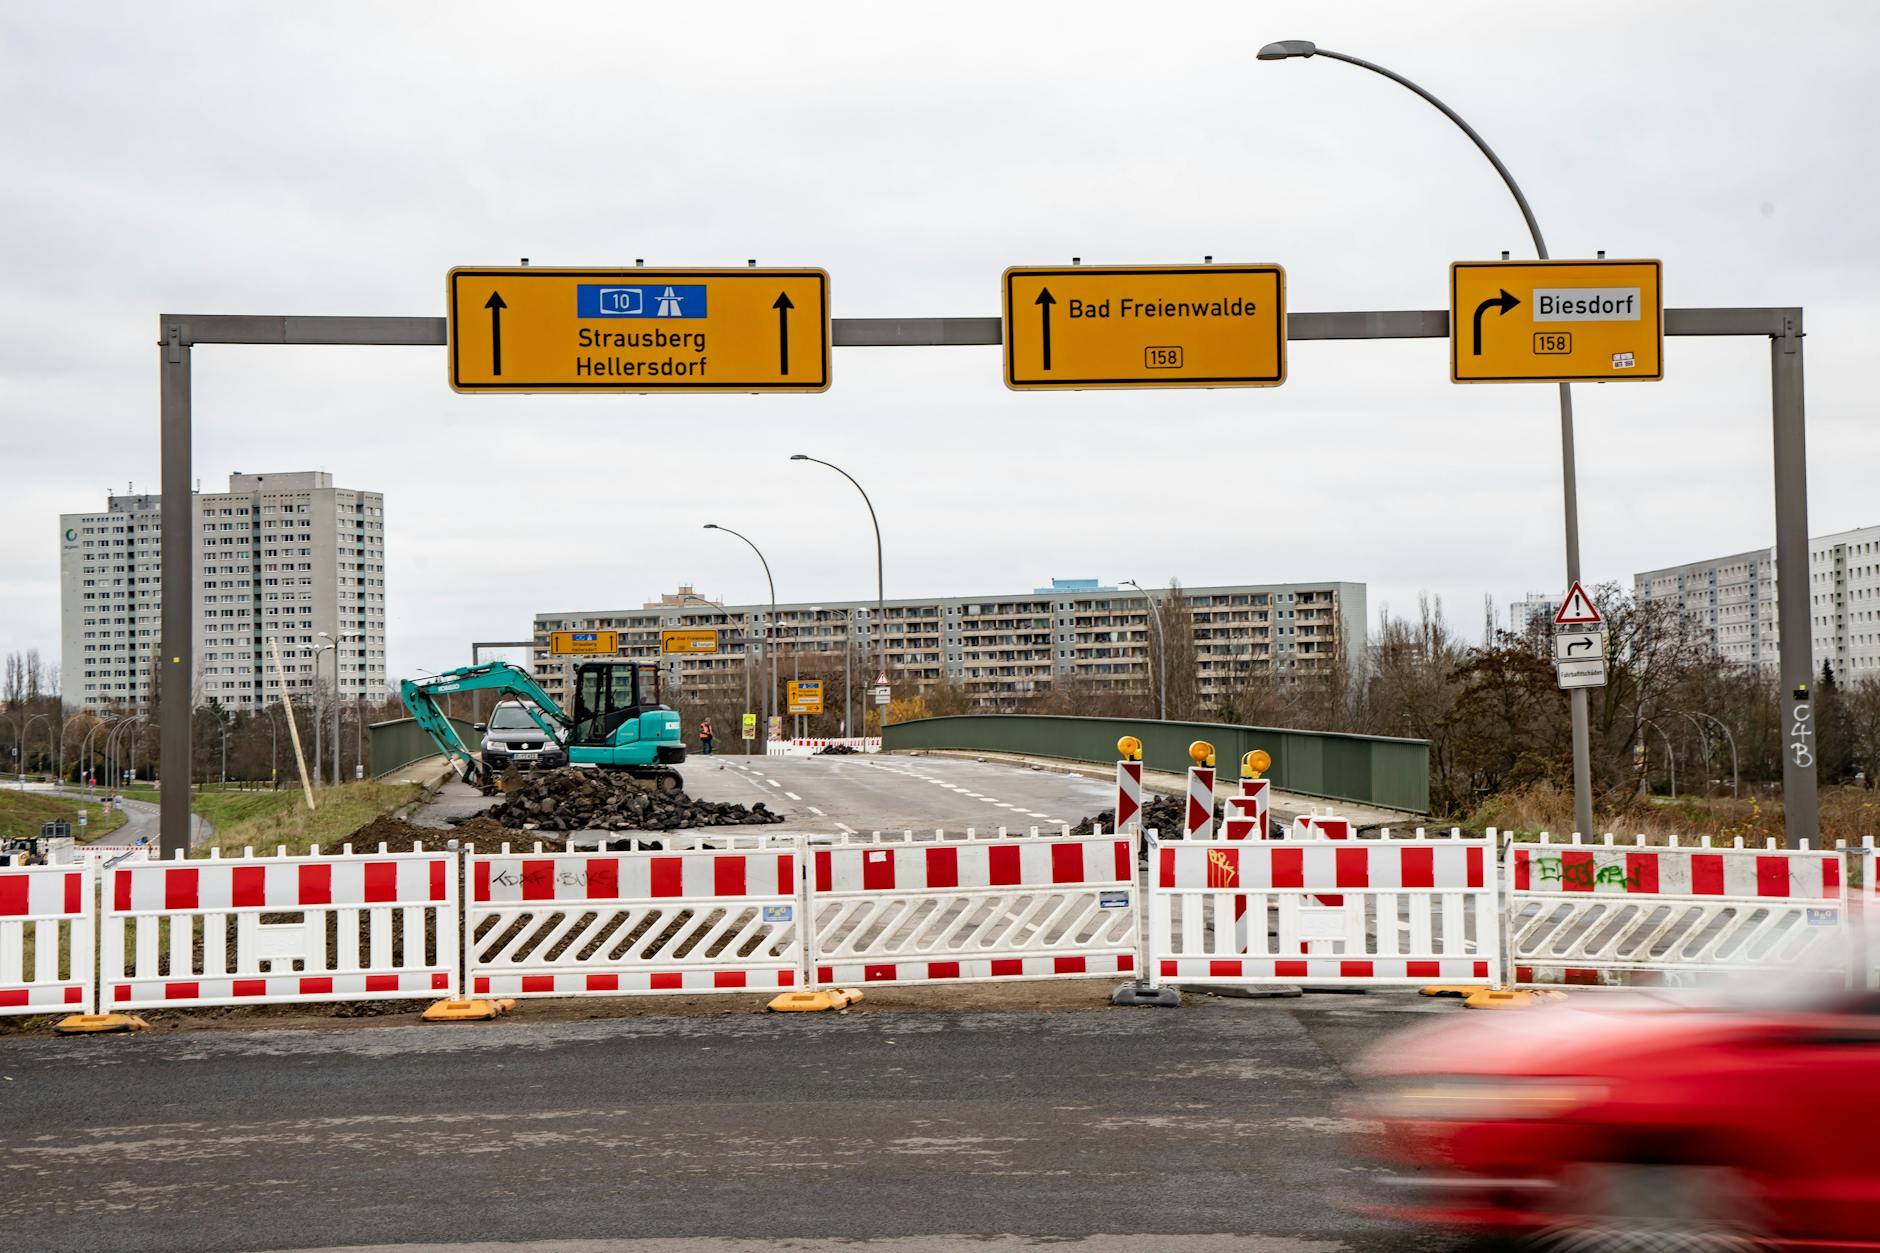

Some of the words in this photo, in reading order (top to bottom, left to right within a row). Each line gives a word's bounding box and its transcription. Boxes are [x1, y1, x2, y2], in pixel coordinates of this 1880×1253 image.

[613, 294, 630, 309] 10
[1069, 299, 1110, 318] Bad
[1121, 297, 1256, 318] Freienwalde
[1540, 295, 1634, 314] Biesdorf
[578, 328, 706, 352] Strausberg
[1539, 336, 1566, 350] 158
[577, 356, 707, 376] Hellersdorf
[1150, 350, 1177, 365] 158
[1790, 704, 1813, 768] C4B
